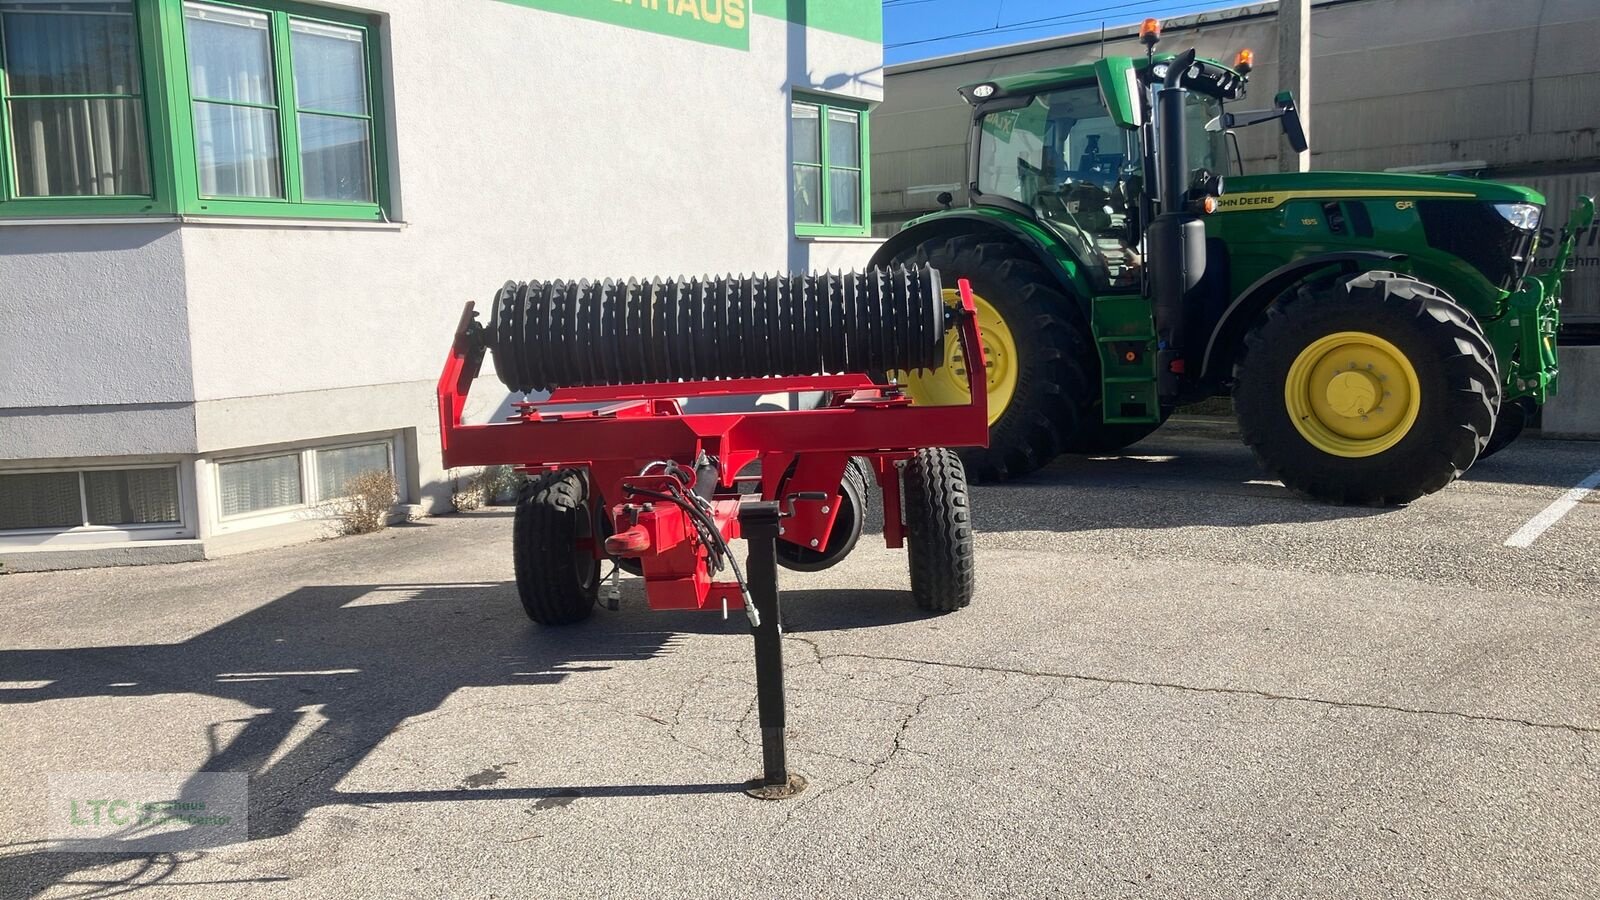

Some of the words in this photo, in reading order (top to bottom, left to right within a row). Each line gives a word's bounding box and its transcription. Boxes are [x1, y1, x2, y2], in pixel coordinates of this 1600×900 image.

[1217, 198, 1238, 207] OHN
[1240, 196, 1275, 206] DEERE
[1395, 201, 1414, 210] 6R
